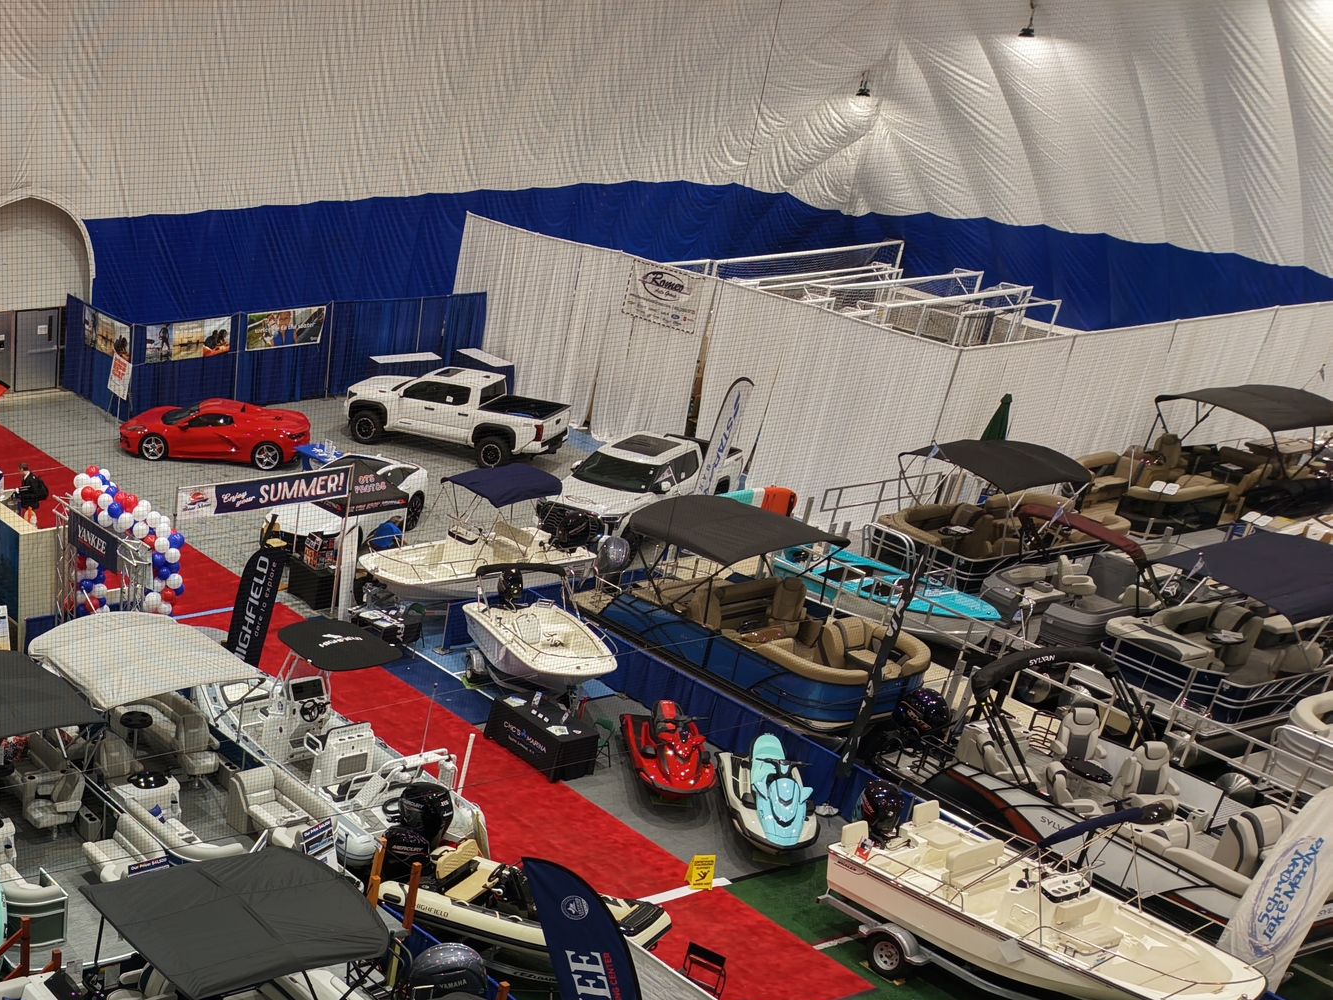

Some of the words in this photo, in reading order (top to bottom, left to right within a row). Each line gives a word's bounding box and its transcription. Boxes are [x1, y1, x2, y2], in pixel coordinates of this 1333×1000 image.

[651, 273, 685, 293] Romeo
[222, 490, 248, 504] Enjoy
[259, 472, 345, 504] SUMMER!
[236, 495, 256, 508] your
[77, 525, 106, 554] YANKEE
[234, 555, 270, 660] HIGHFIELD
[254, 619, 263, 637] dare
[265, 561, 277, 598] explore
[1028, 654, 1056, 666] SYLVAN
[391, 844, 424, 852] MERCURY
[603, 952, 619, 986] CENTER
[439, 978, 468, 990] YAMAHA
